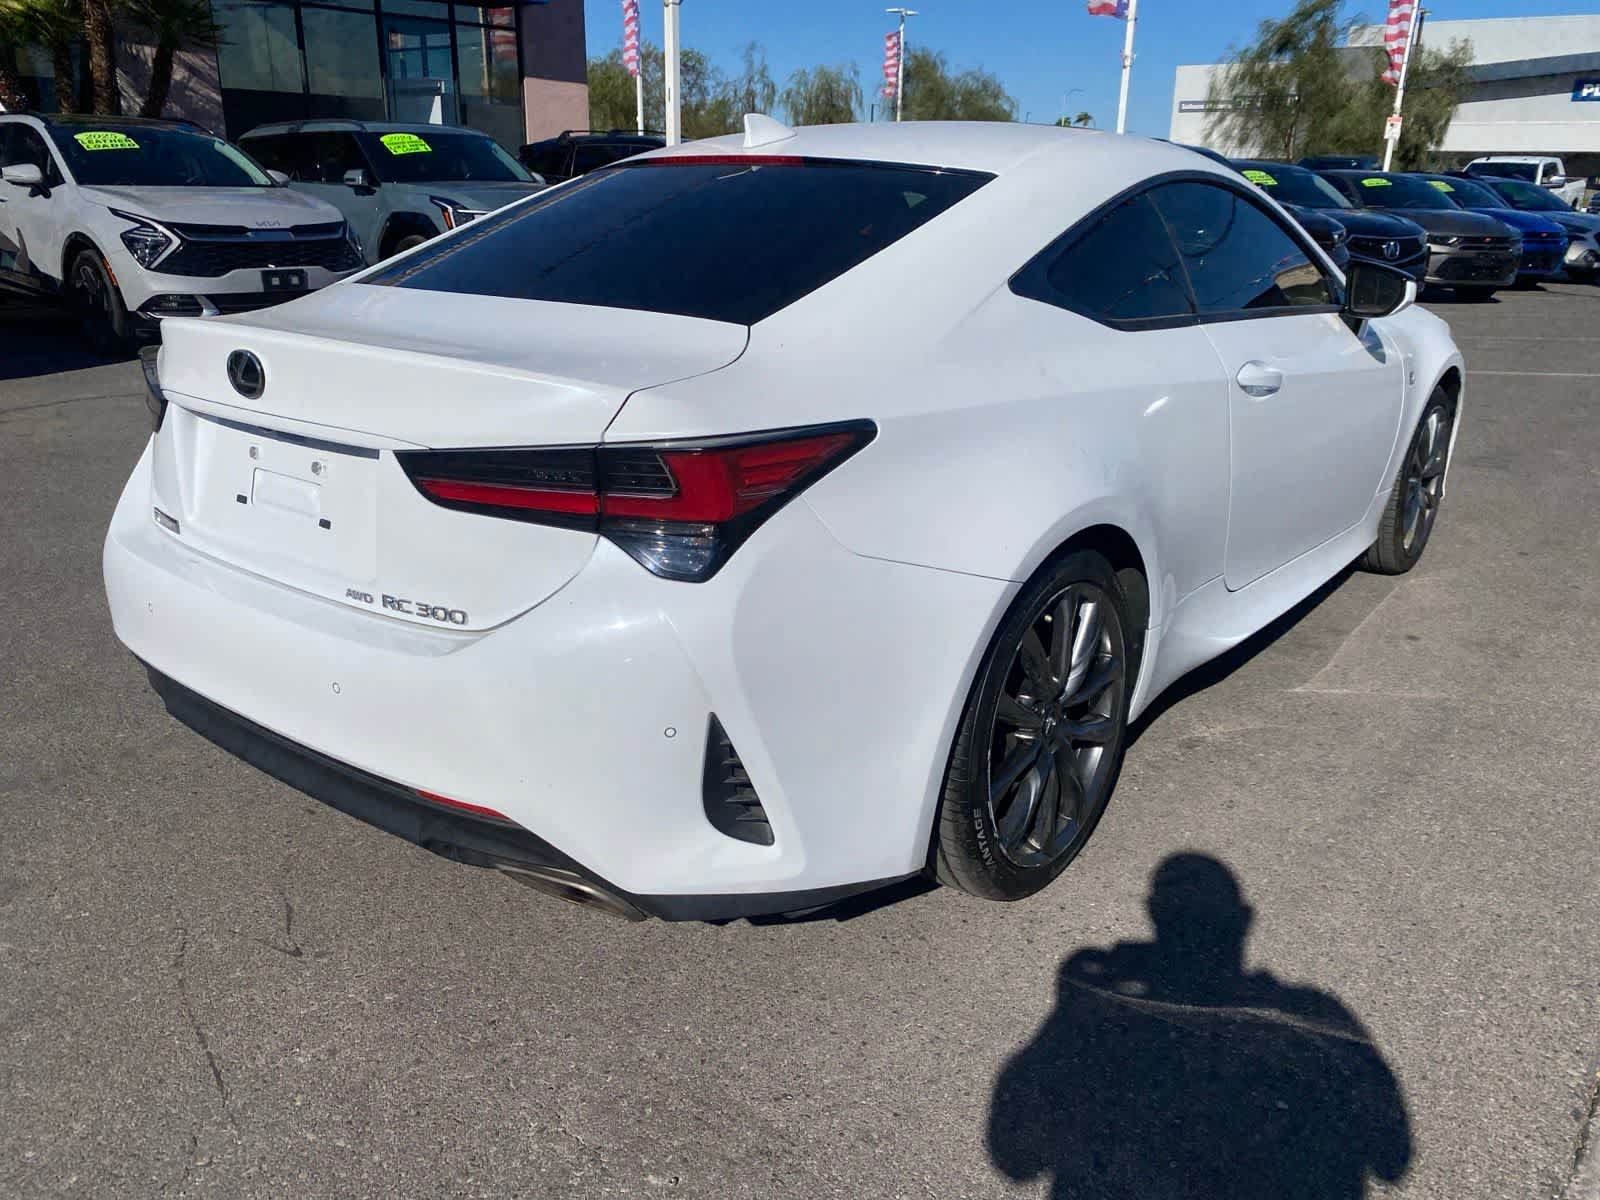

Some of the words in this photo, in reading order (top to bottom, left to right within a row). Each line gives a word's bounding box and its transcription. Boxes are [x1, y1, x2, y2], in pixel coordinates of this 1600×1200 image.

[345, 588, 374, 604] AWD
[382, 593, 414, 615] RC
[416, 602, 468, 625] 300
